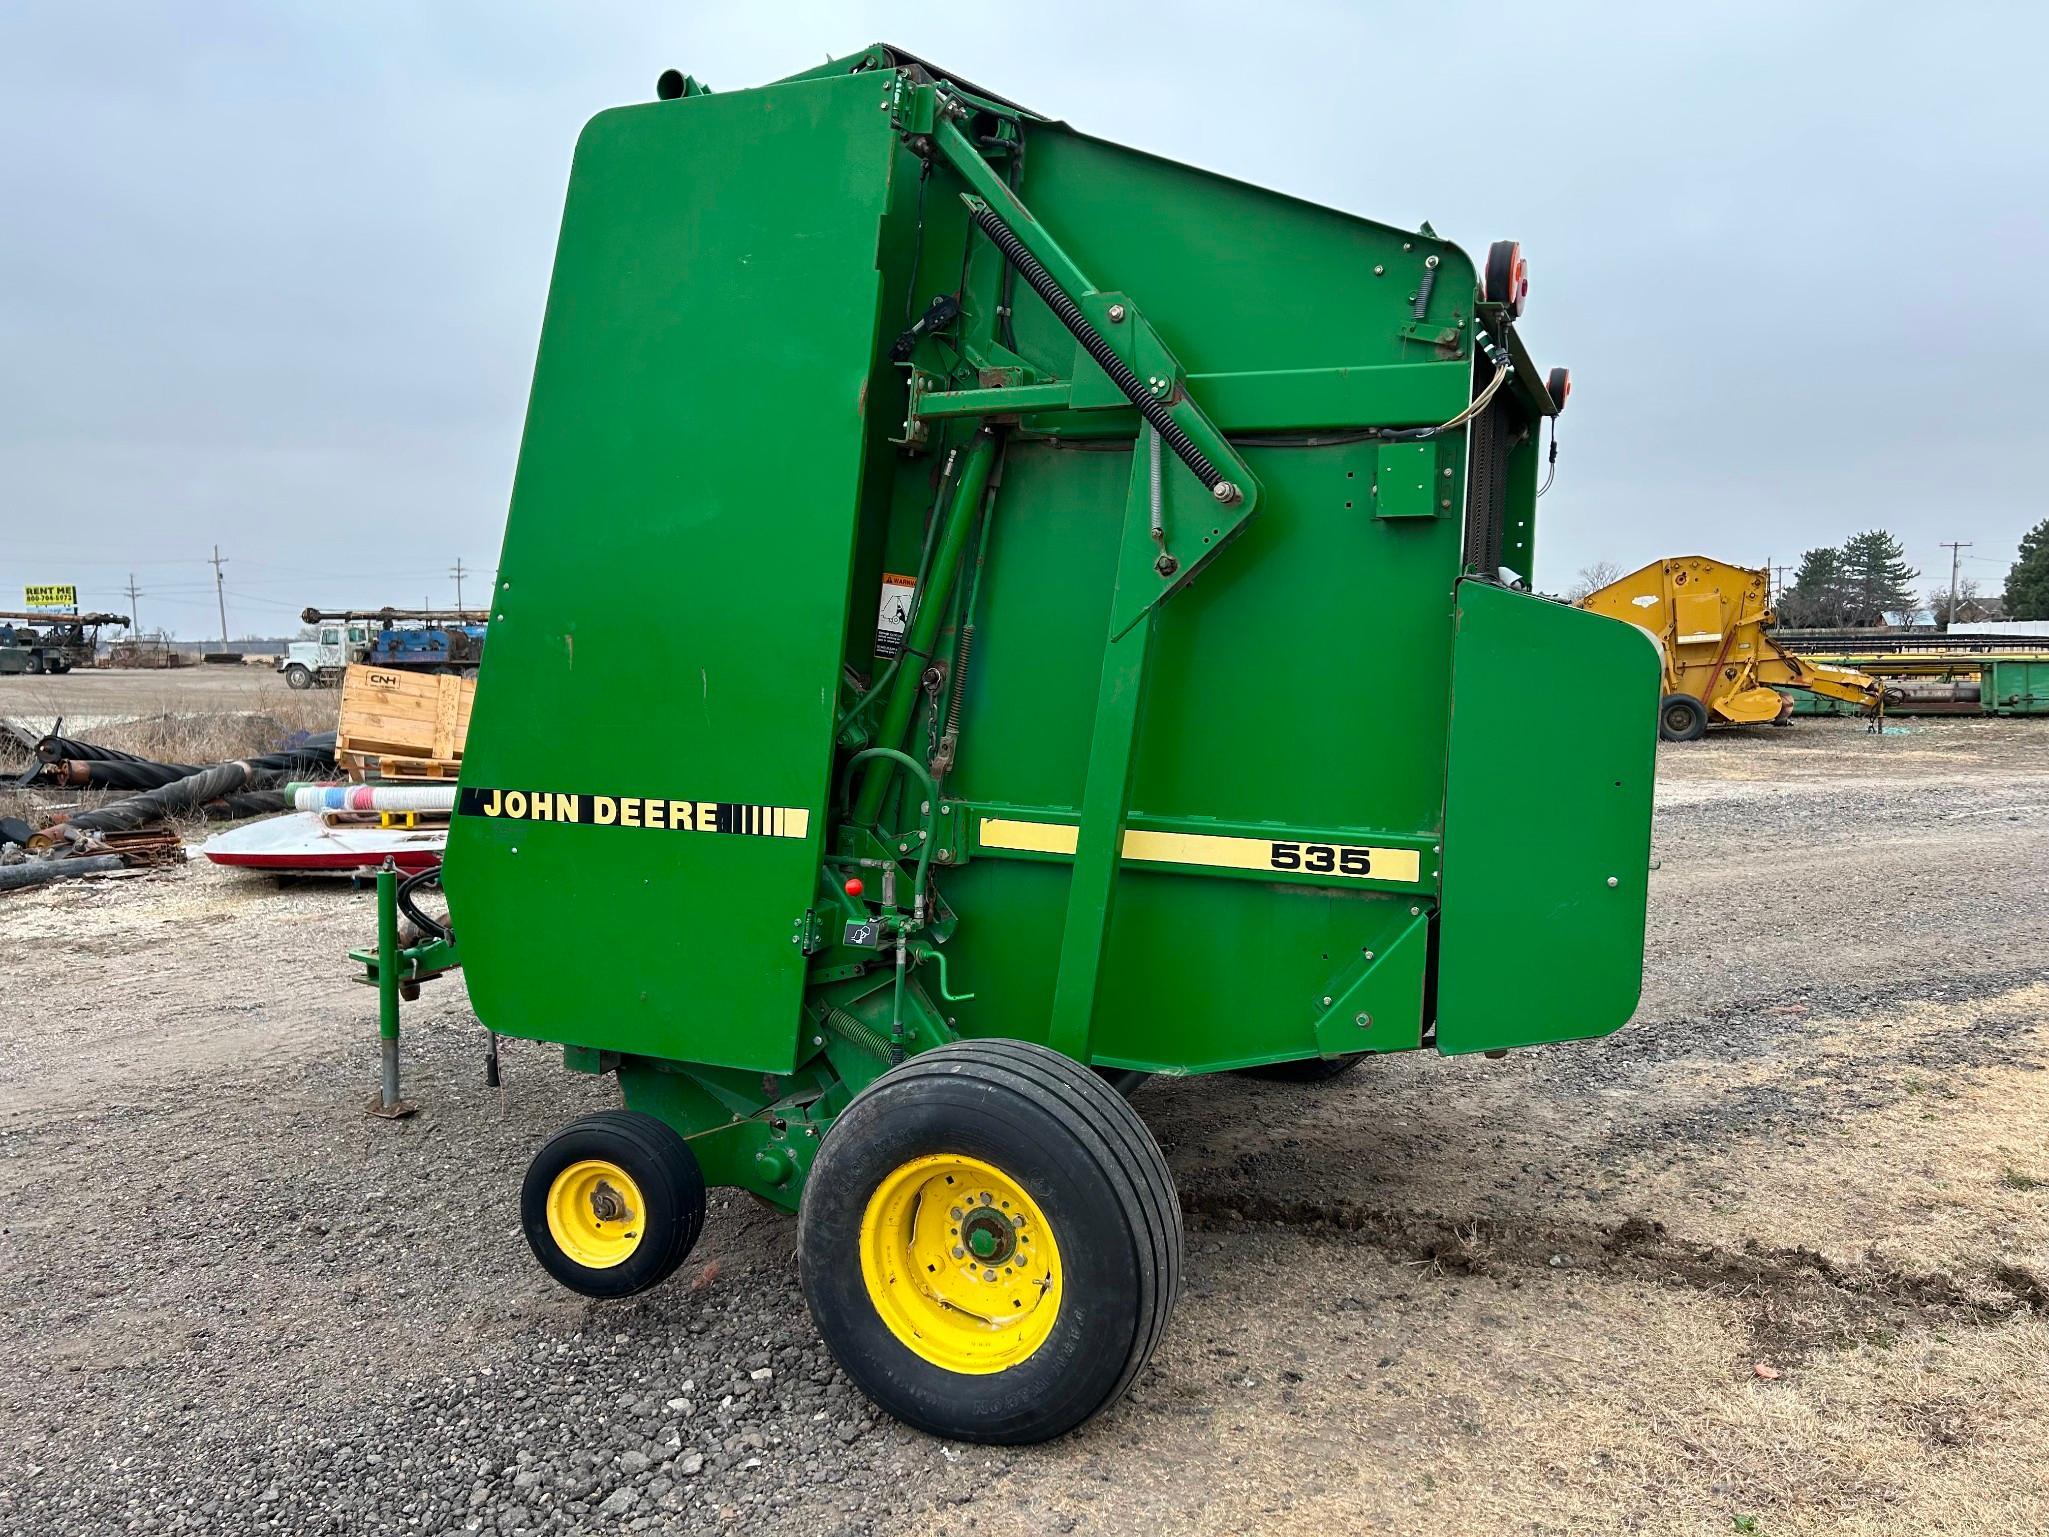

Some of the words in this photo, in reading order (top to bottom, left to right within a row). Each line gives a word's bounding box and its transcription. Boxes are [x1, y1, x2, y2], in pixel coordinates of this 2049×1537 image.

[26, 587, 54, 595] RENT
[56, 587, 71, 595] ME
[370, 674, 397, 685] CNH
[483, 789, 579, 823] JOHN
[593, 796, 718, 832] DEERE
[1271, 843, 1371, 875] 535
